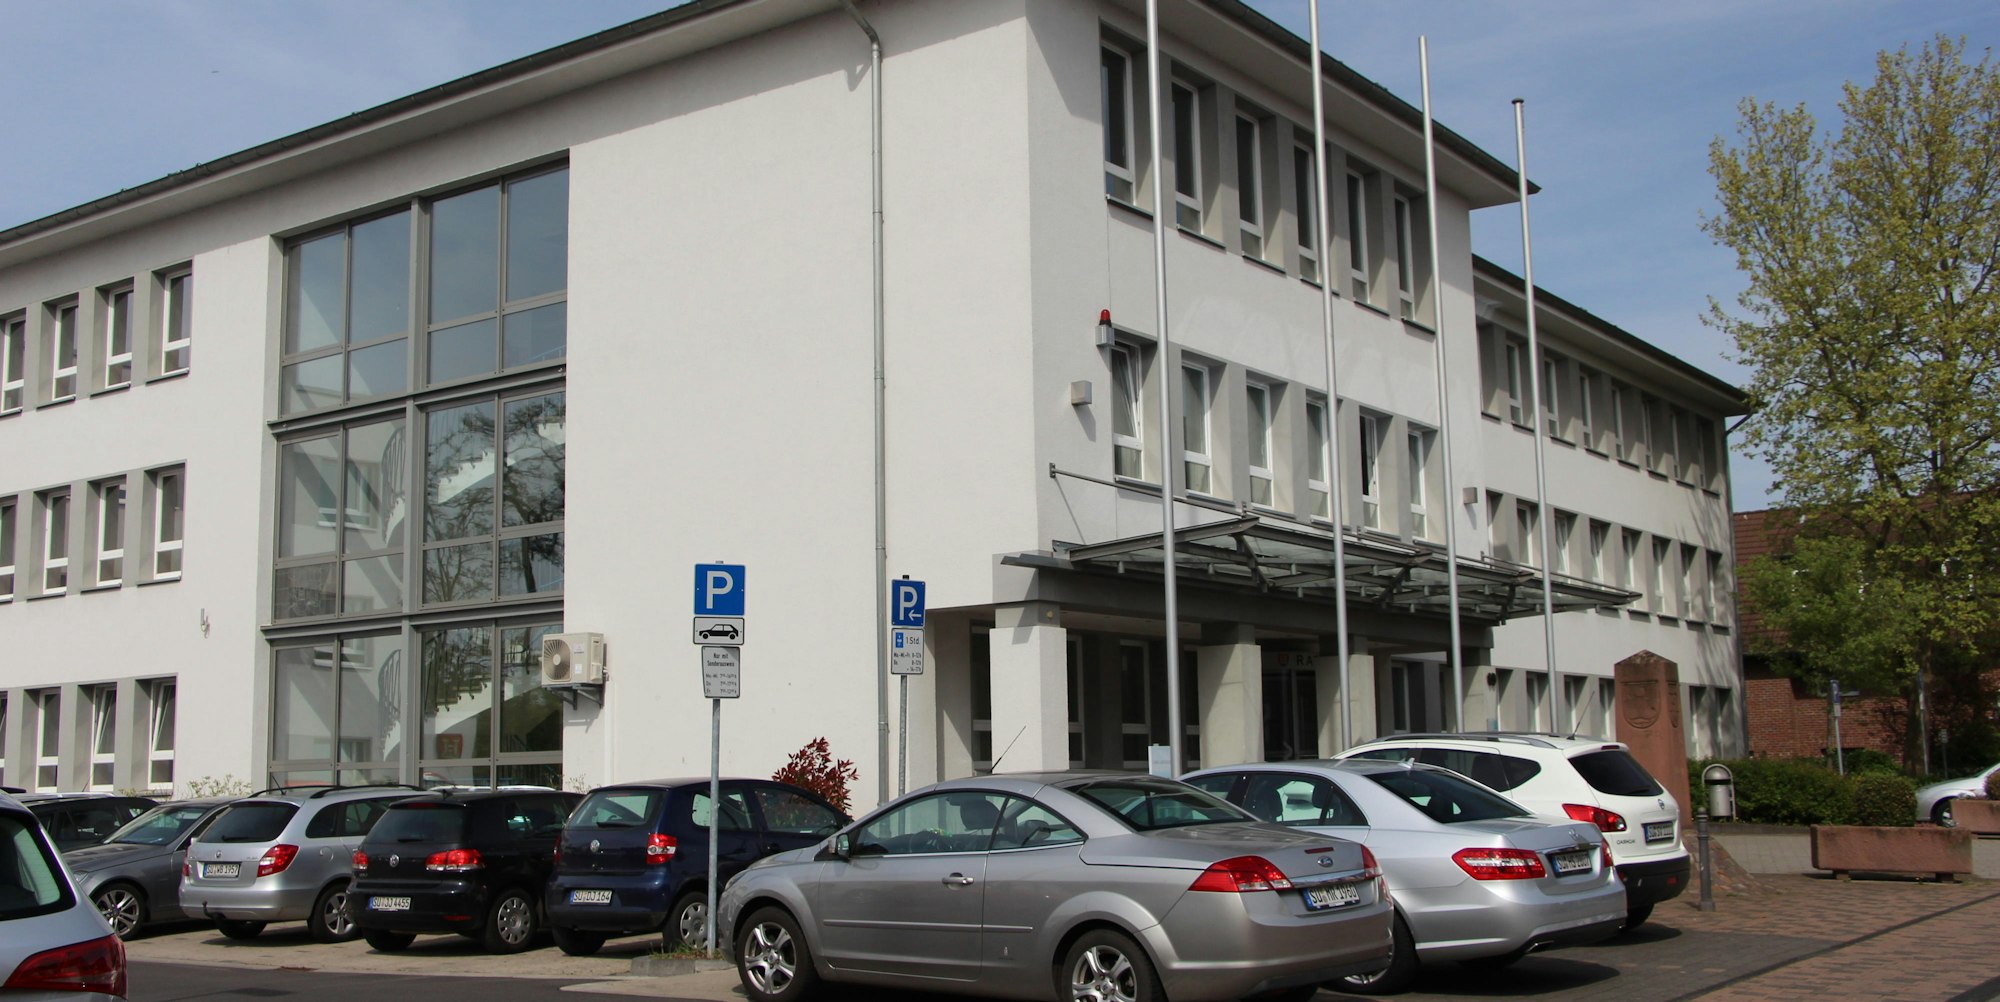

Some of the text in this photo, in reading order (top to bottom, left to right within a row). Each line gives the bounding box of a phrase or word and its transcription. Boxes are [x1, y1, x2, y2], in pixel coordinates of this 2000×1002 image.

[706, 571, 733, 609] P
[899, 586, 918, 620] P
[1296, 655, 1316, 666] RA
[574, 890, 582, 900] SU
[1310, 889, 1322, 904] SU
[373, 897, 381, 907] SU
[394, 898, 410, 908] 4455
